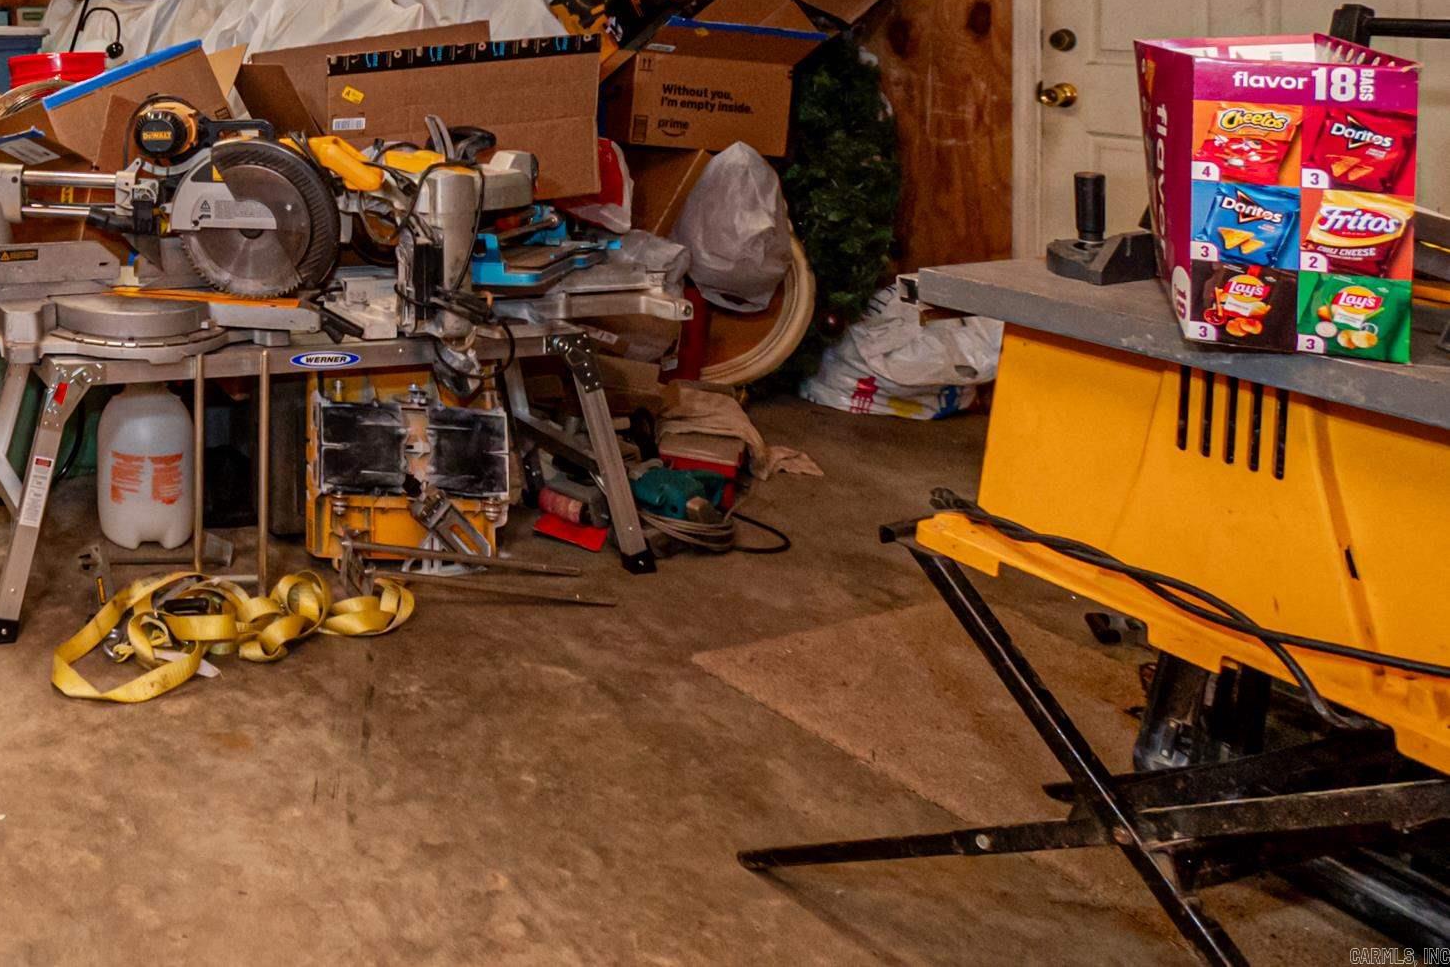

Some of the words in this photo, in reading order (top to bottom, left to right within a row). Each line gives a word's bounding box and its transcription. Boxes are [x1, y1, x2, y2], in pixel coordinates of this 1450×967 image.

[662, 82, 704, 100] Without
[707, 87, 734, 103] you,
[1232, 70, 1308, 90] flavor
[1311, 66, 1357, 103] 18
[1359, 68, 1376, 103] BAGS
[661, 96, 679, 109] I'm
[681, 98, 716, 115] empty
[717, 100, 754, 115] inside.
[657, 117, 690, 133] prime
[1219, 108, 1288, 131] Cheetos
[1330, 121, 1394, 149] Doritos
[1201, 165, 1212, 178] 4
[1309, 172, 1320, 185] 3
[1221, 195, 1283, 224] Doritos
[1318, 205, 1400, 234] Fritos
[1200, 245, 1210, 258] 3
[1316, 245, 1340, 256] CHILI
[1341, 246, 1377, 258] CHEESE
[1308, 255, 1319, 269] 2
[1228, 280, 1264, 298] Lay's
[1338, 291, 1376, 309] Lay's
[1198, 325, 1209, 338] 3
[1305, 337, 1316, 351] 3
[304, 354, 349, 365] WERNER
